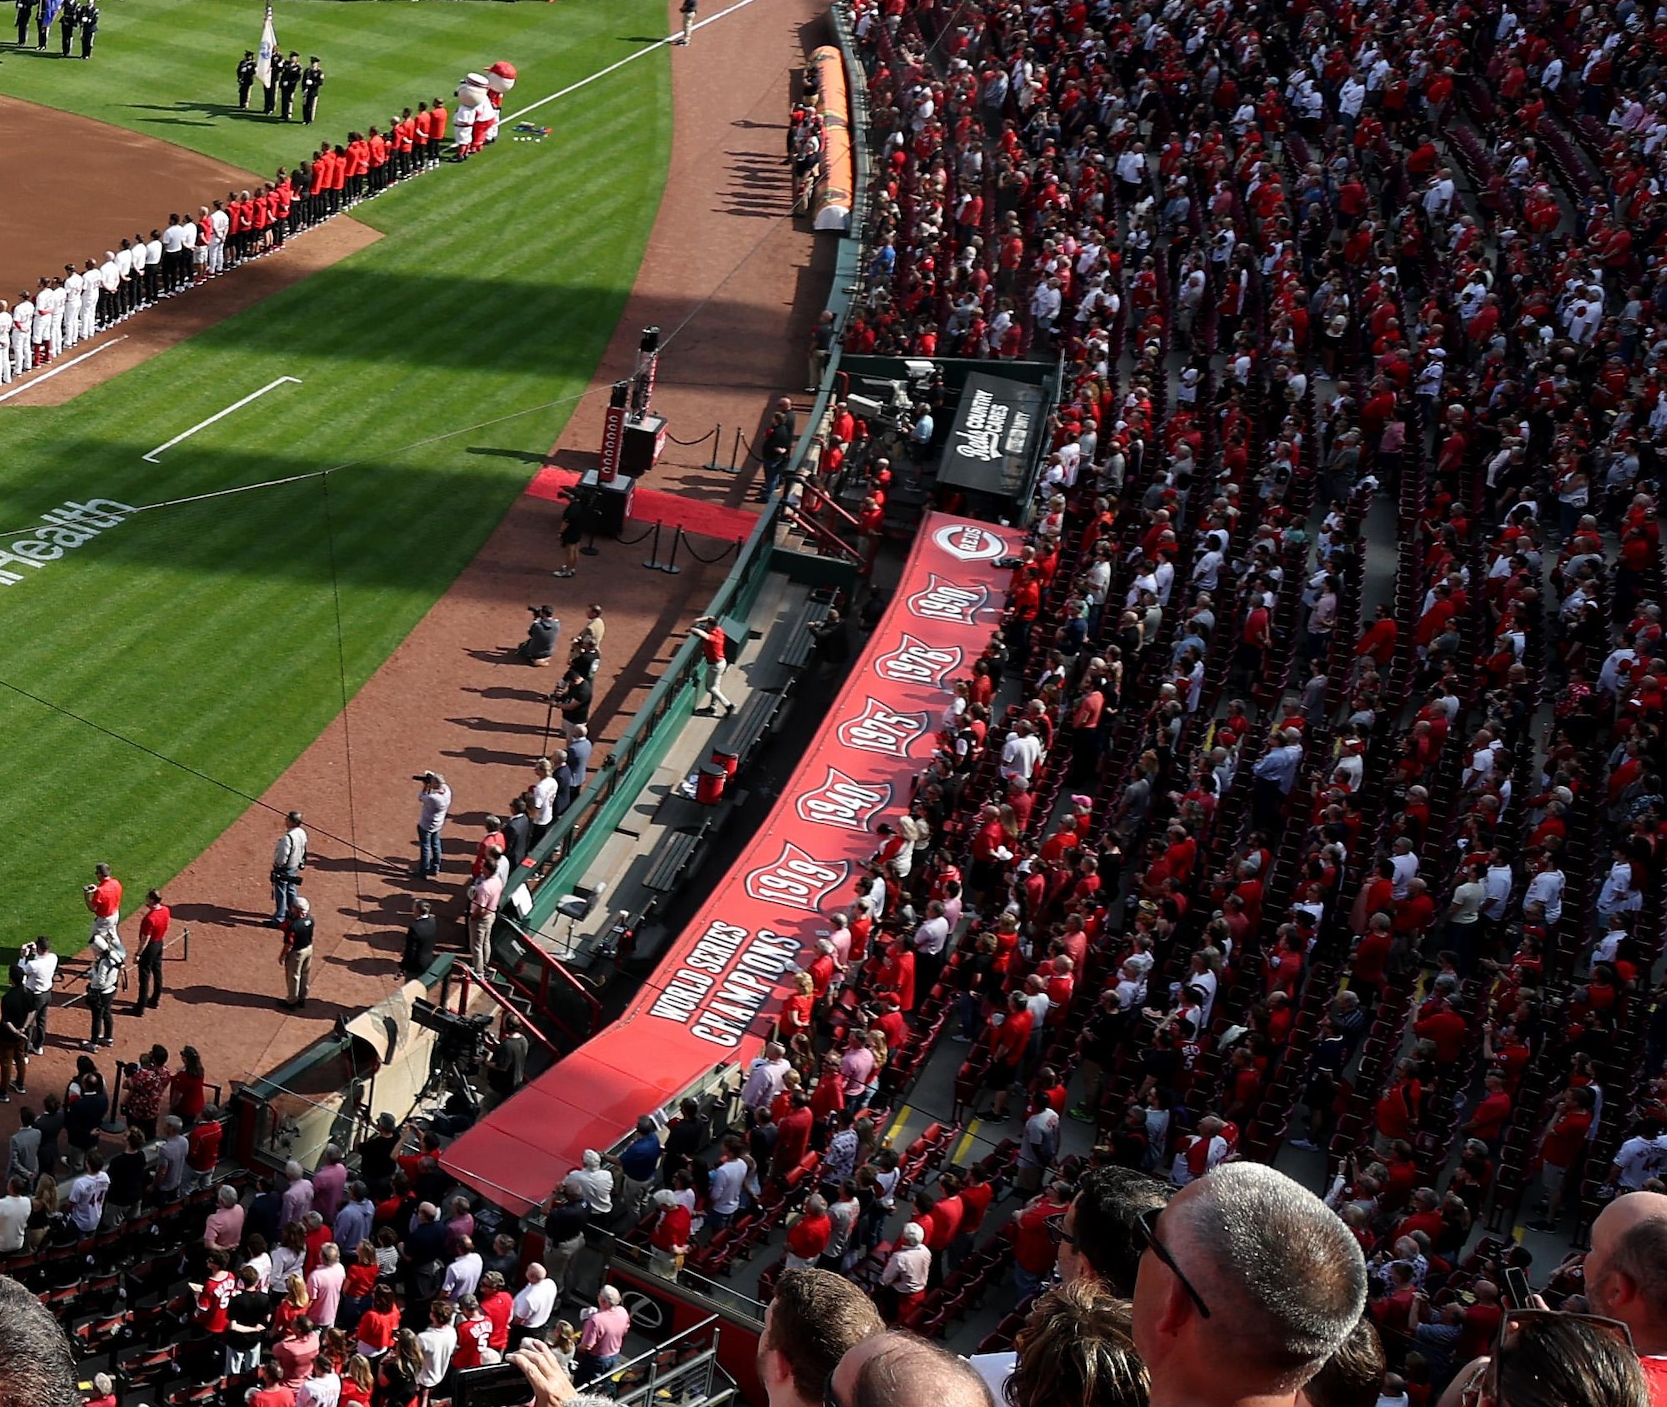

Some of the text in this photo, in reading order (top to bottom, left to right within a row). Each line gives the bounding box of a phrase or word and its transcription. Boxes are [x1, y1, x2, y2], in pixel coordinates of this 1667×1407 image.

[966, 389, 995, 431] COUNTRY
[956, 403, 1010, 462] Reds CARES
[958, 525, 983, 552] REDS
[920, 584, 981, 620] 1990
[886, 645, 955, 682] 1976
[849, 707, 921, 750] 1975
[809, 781, 881, 824] 1940
[757, 857, 840, 905] 1919
[648, 920, 749, 1024] WORLD SERIES
[689, 928, 803, 1048] CHAMPIONS
